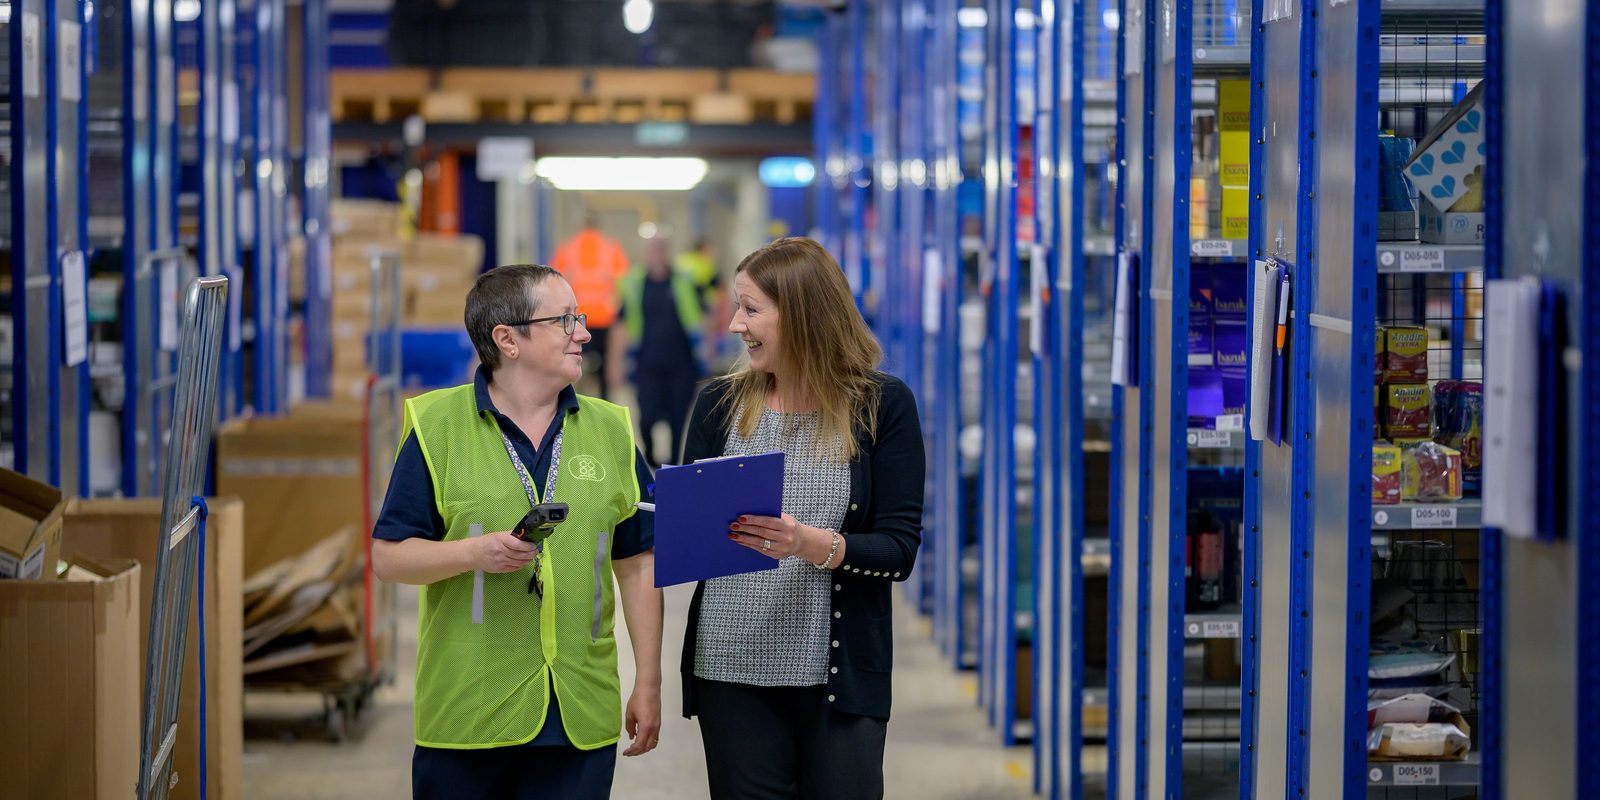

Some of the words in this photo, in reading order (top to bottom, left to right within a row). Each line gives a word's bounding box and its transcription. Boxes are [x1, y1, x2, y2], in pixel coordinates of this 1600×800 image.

[1404, 250, 1439, 260] D05-050
[1416, 509, 1451, 518] D05-100
[1398, 766, 1433, 775] D05-150
